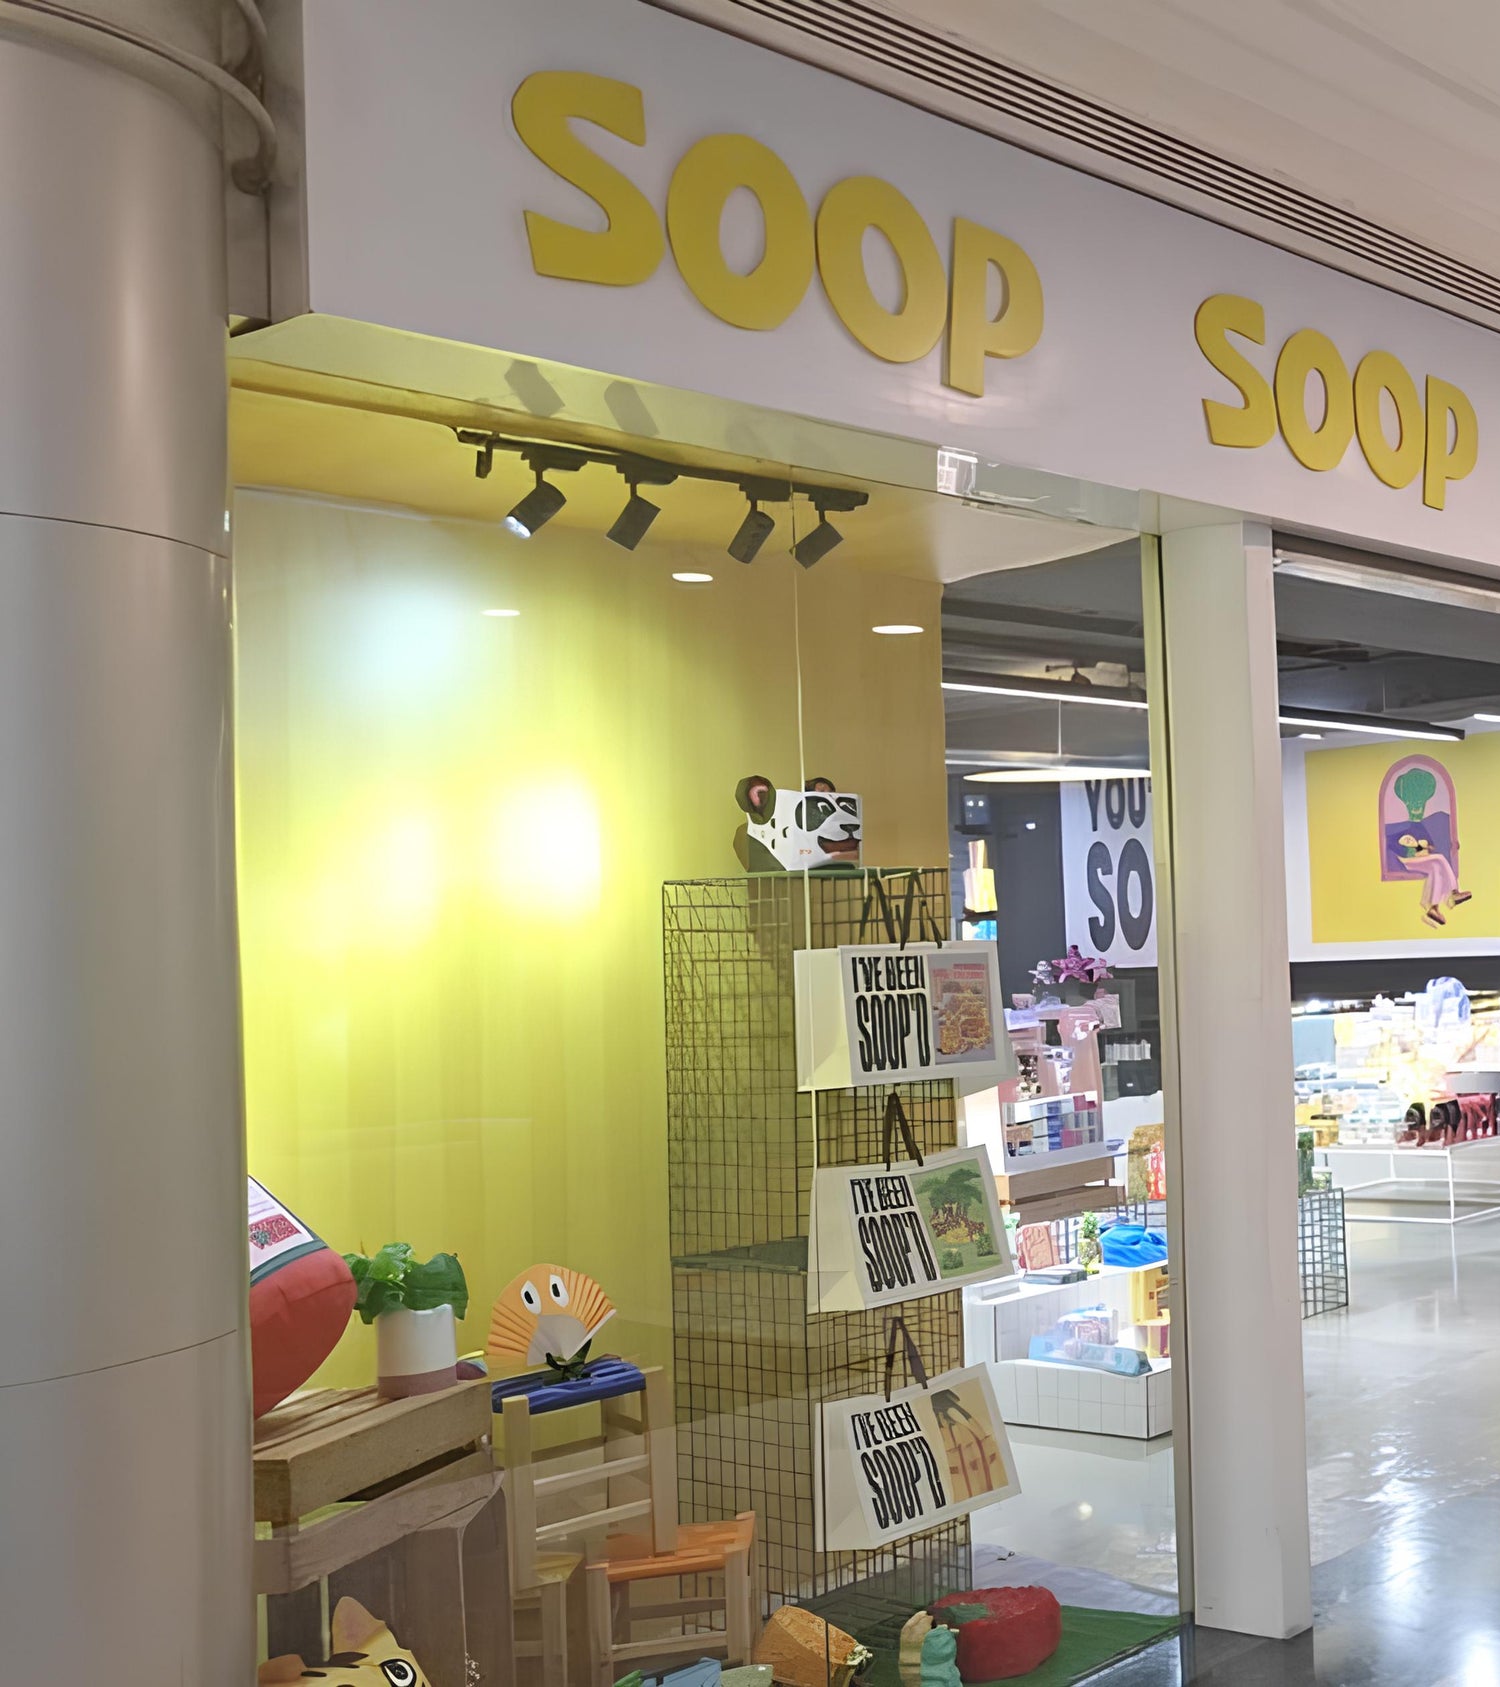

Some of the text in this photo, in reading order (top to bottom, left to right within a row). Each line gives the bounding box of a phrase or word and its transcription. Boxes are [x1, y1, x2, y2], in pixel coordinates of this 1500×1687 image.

[511, 70, 1043, 396] SOOP
[1196, 293, 1478, 509] SOOP
[855, 992, 931, 1073] SOOP'D
